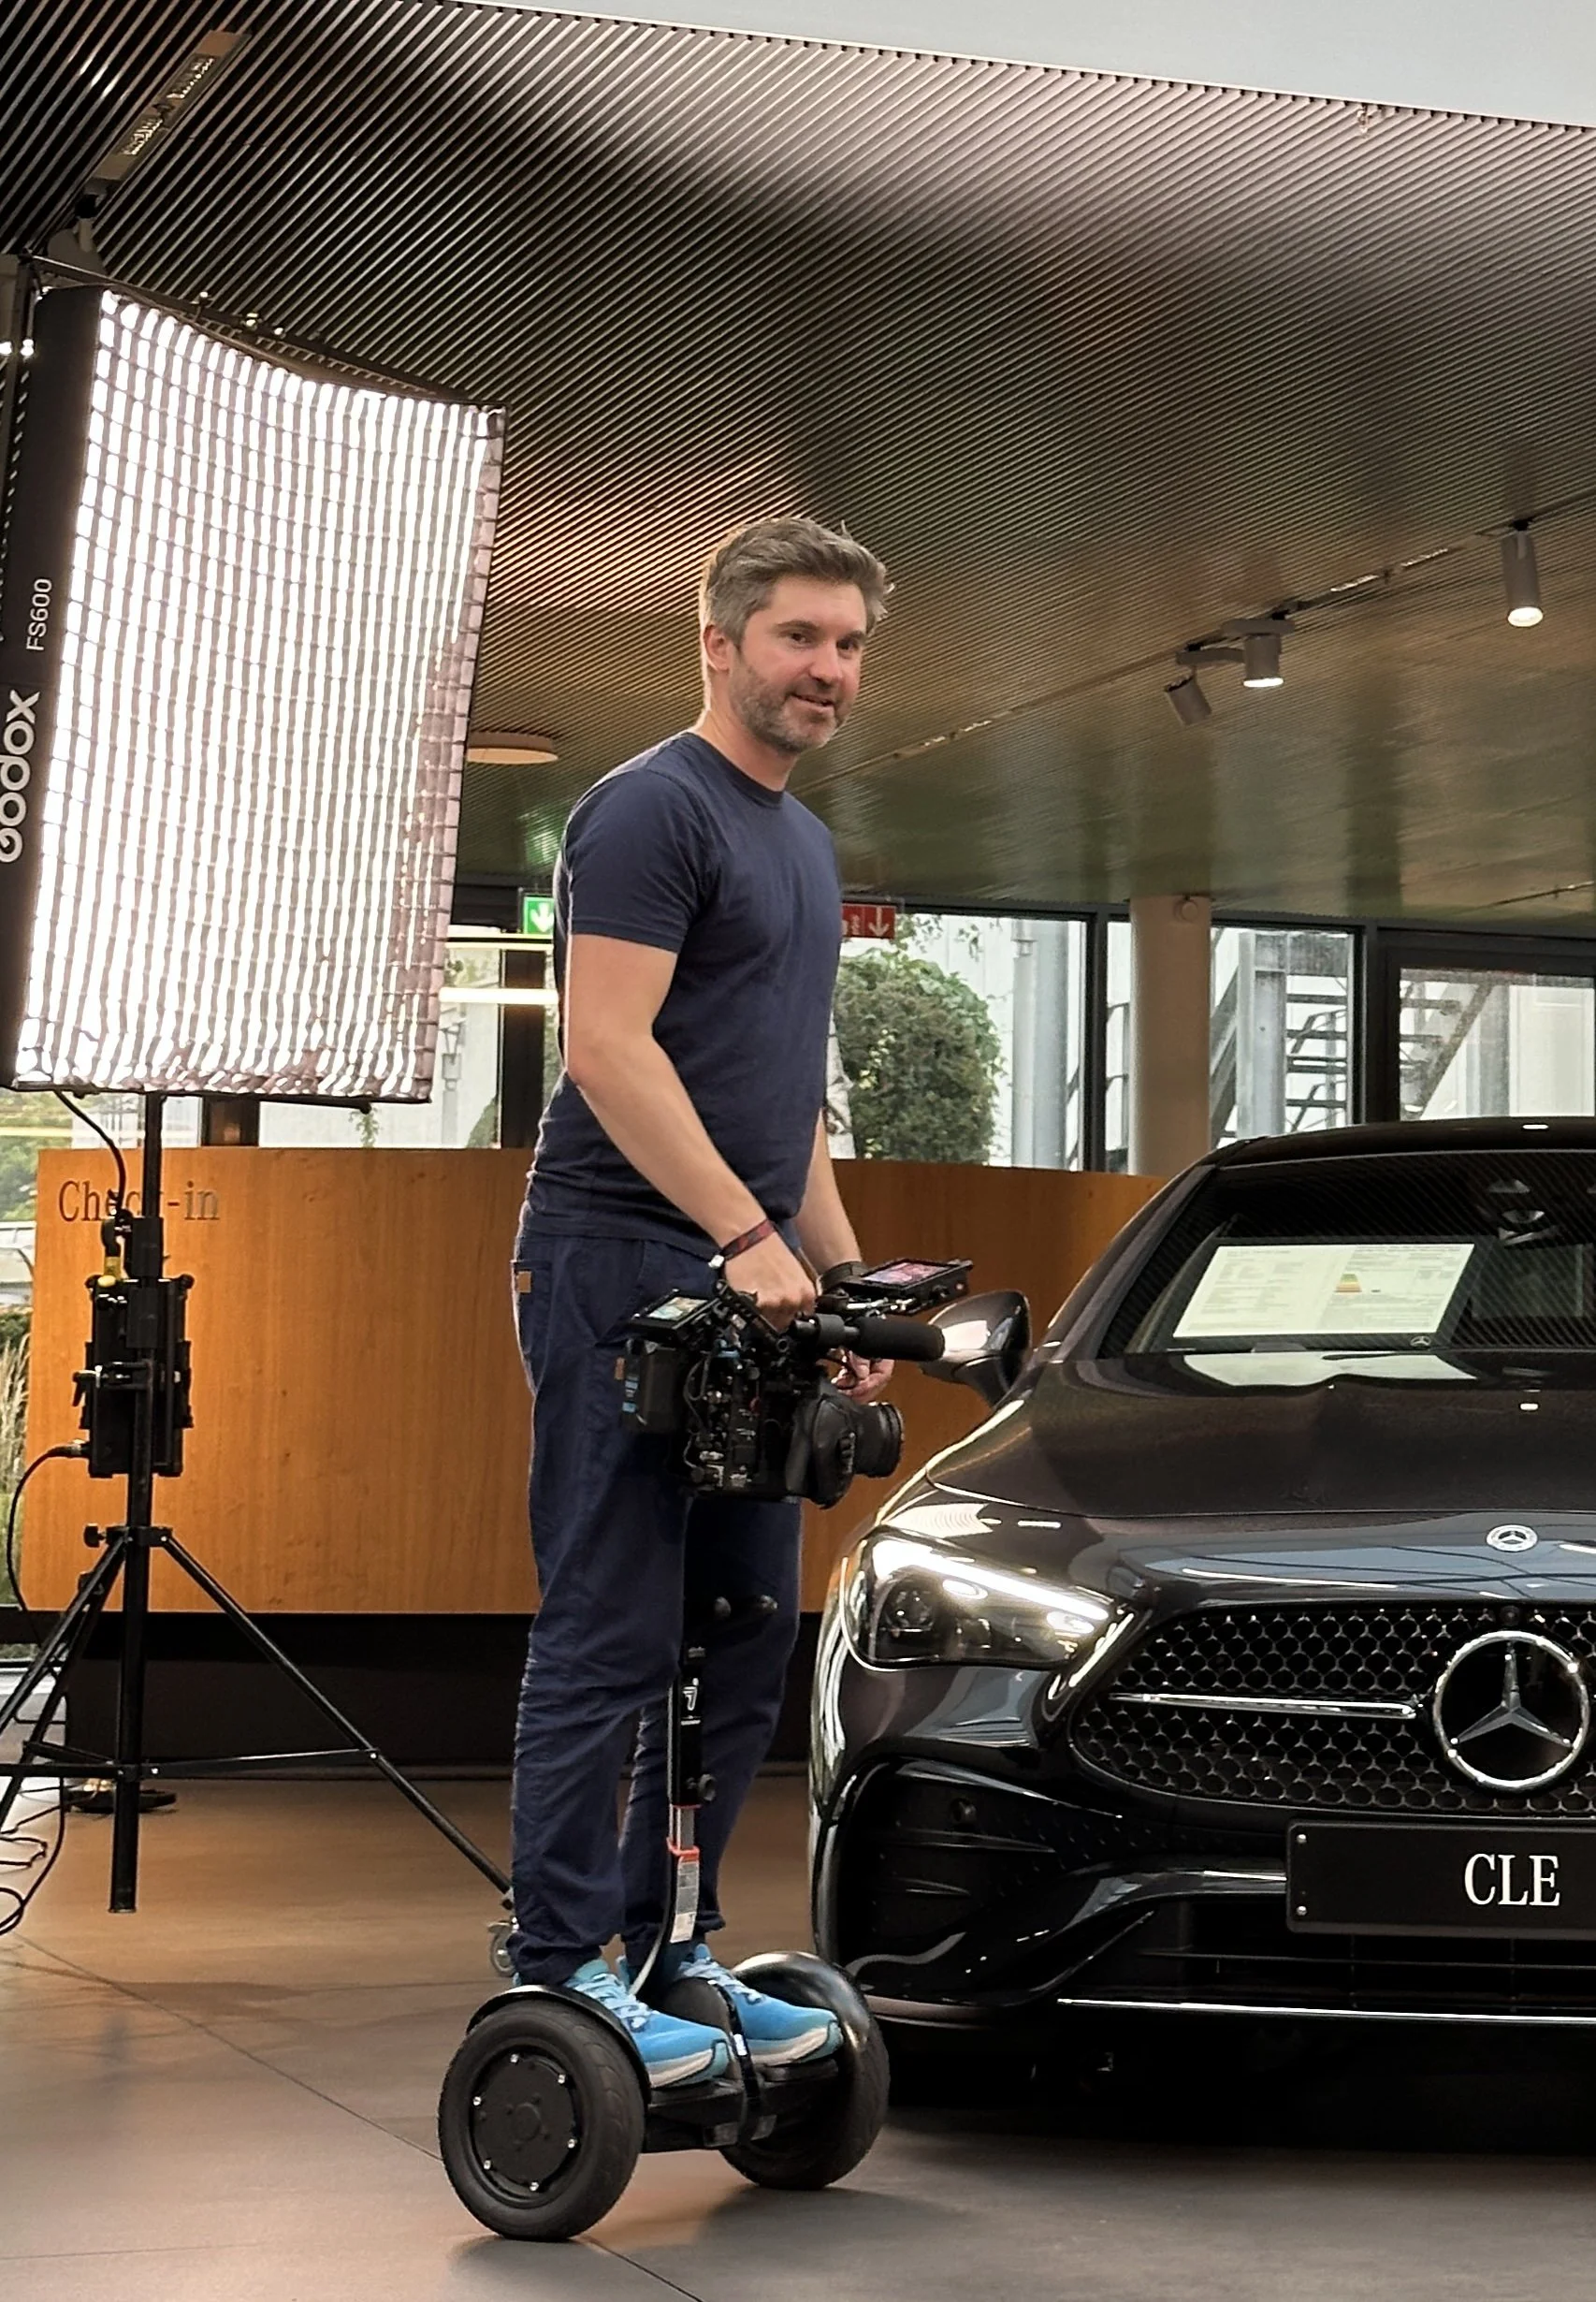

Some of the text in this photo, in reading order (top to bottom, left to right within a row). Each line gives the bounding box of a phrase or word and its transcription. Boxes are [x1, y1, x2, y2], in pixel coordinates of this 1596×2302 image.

[26, 578, 52, 651] FS600
[0, 690, 40, 863] Godox
[59, 1180, 220, 1222] Chec-in
[1464, 1853, 1560, 1906] CLE
